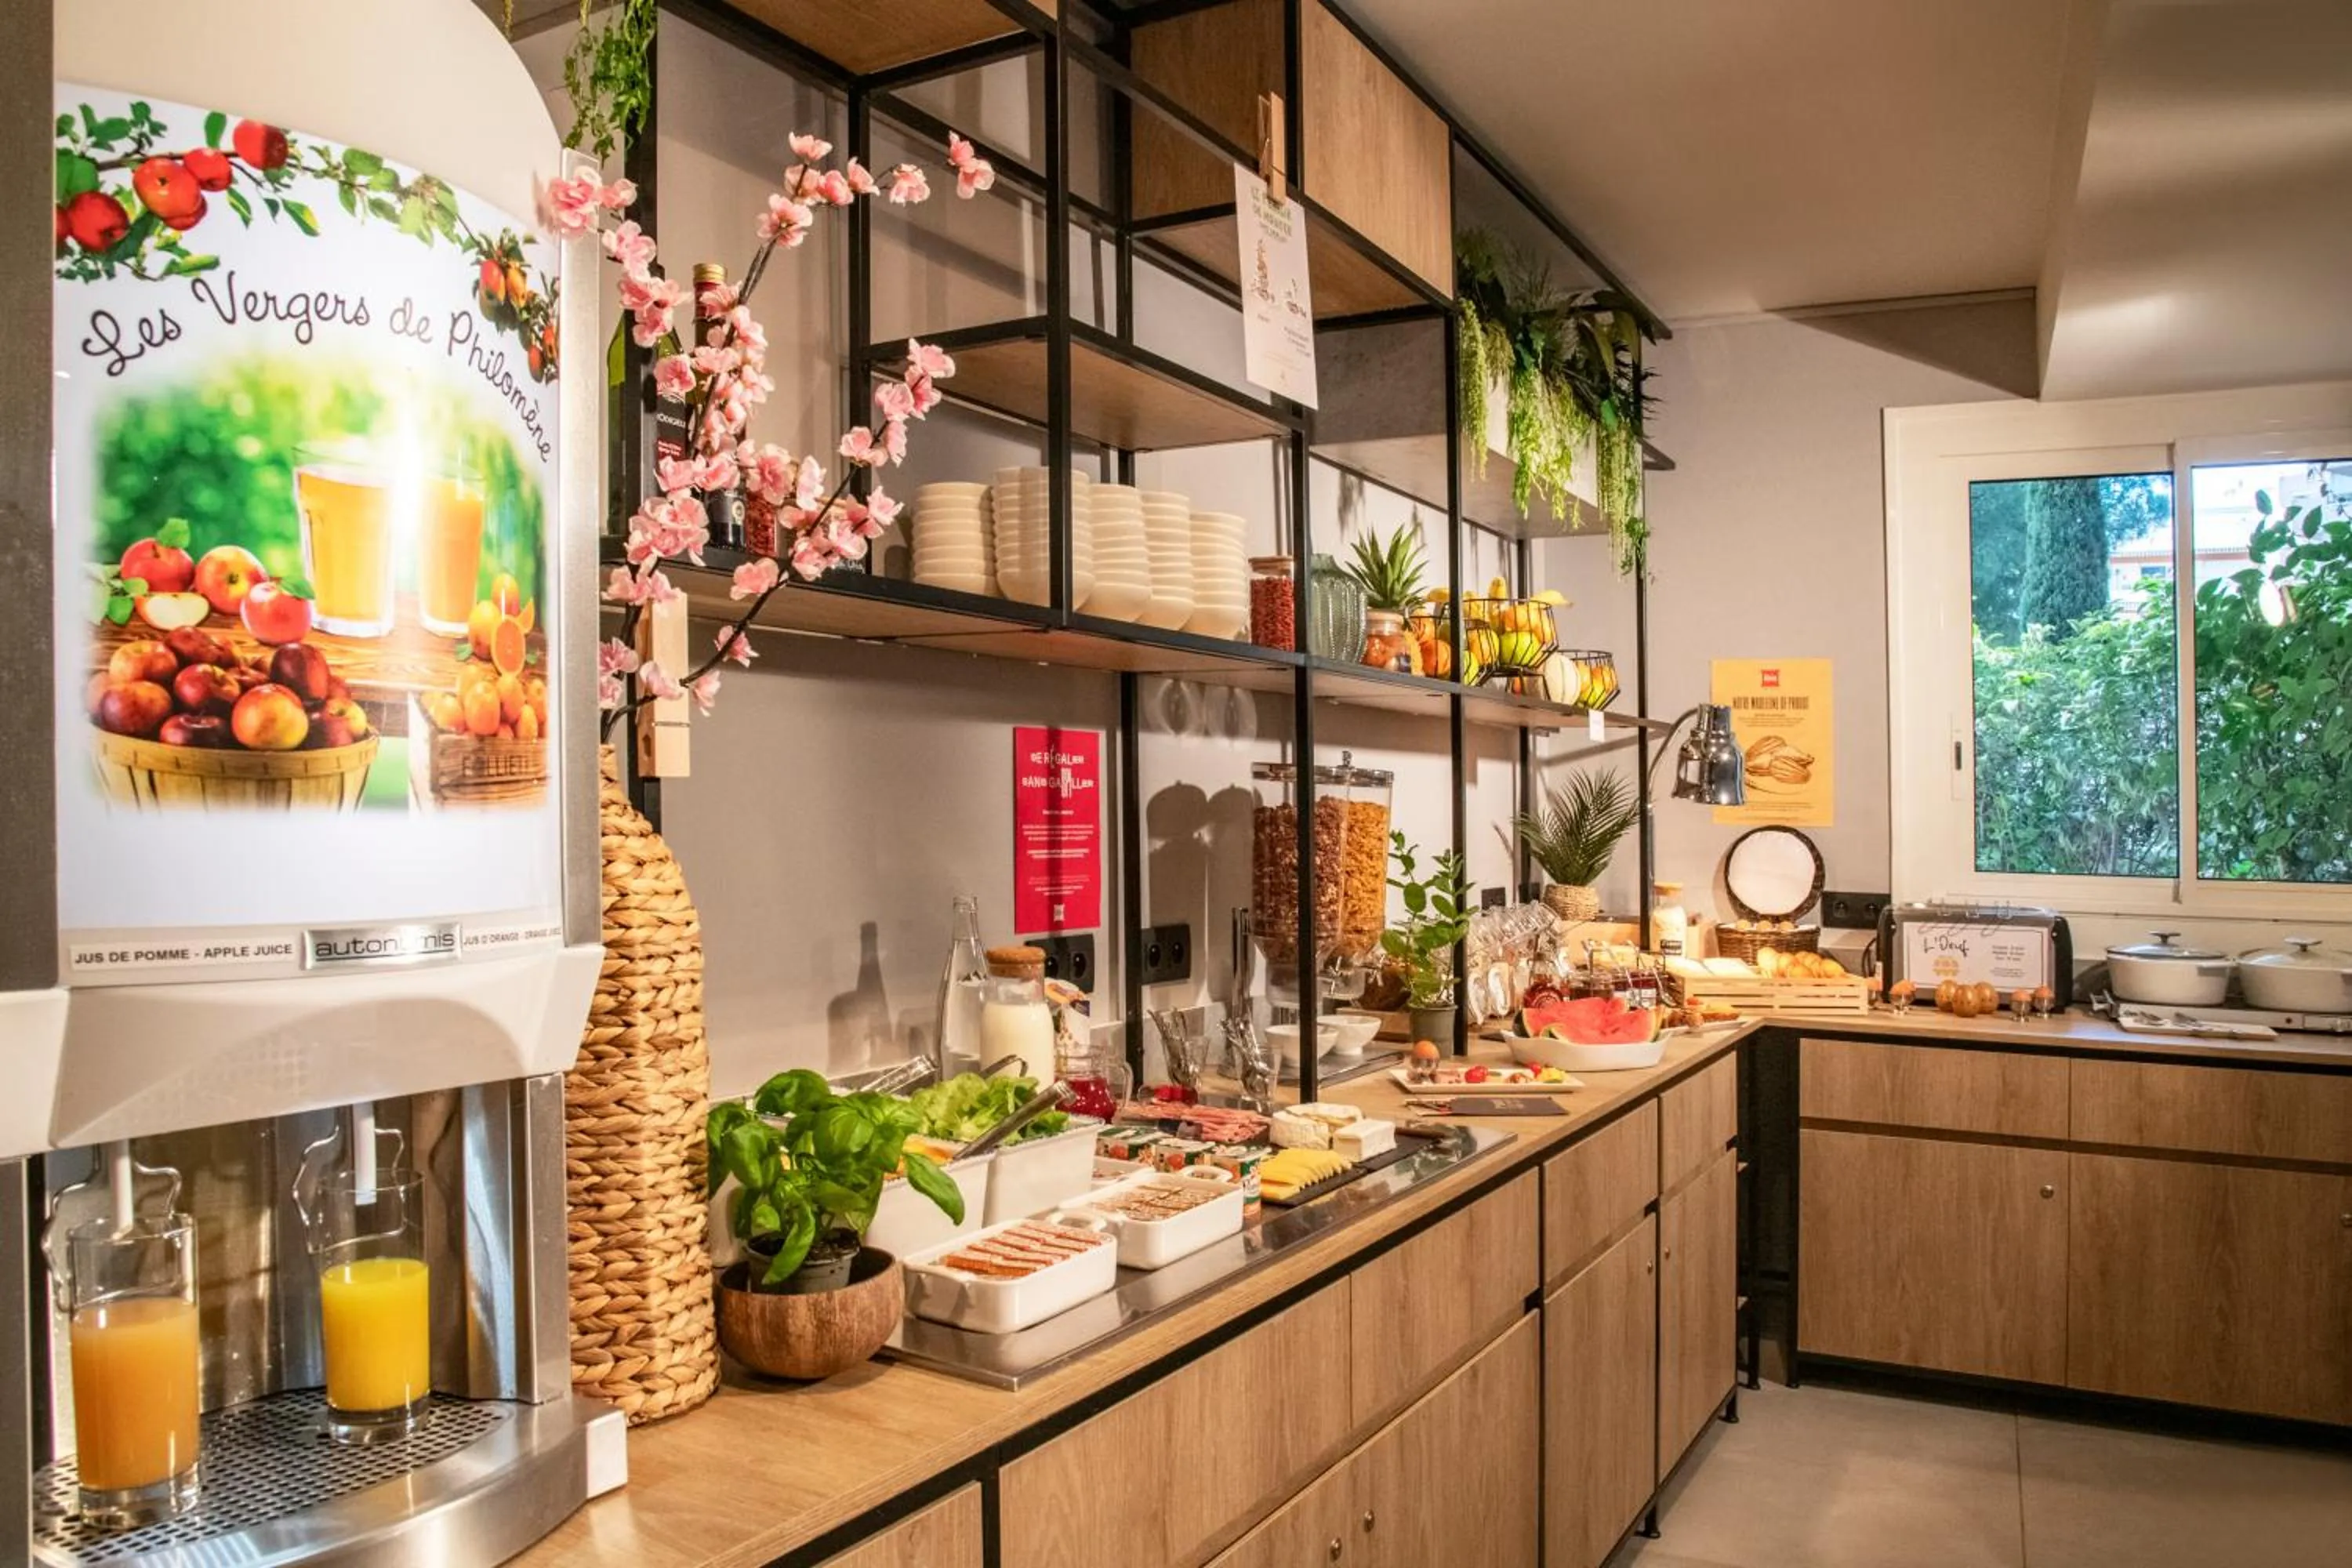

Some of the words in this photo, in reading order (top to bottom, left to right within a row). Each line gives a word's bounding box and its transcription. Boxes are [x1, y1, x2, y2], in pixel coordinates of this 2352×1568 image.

[82, 308, 182, 376] Les
[192, 270, 371, 345] Vergers
[389, 297, 433, 343] de
[447, 310, 552, 463] Philomène
[74, 952, 104, 964] JUS
[109, 951, 130, 963] DE
[134, 949, 190, 961] POMME
[203, 946, 249, 958] APPLE
[253, 943, 293, 956] JUICE
[315, 931, 455, 956] autonmis
